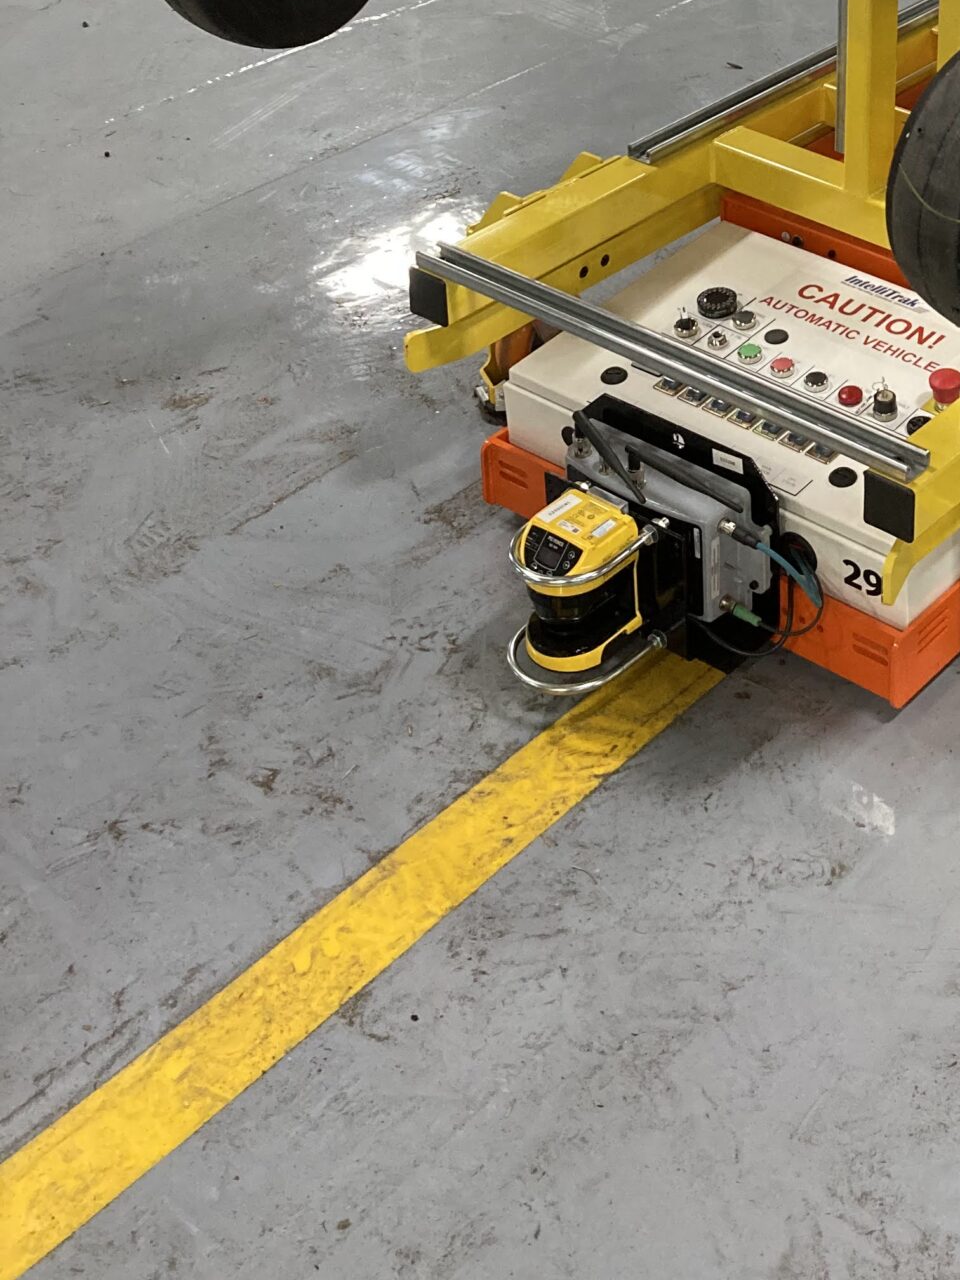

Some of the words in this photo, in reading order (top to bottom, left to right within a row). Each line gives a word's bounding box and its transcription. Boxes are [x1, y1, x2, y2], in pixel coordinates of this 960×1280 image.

[797, 283, 947, 350] CAUTION!
[844, 275, 922, 309] IntelliTrak
[760, 295, 862, 341] AUTOMATIC
[862, 334, 942, 373] VEHICLE
[842, 558, 883, 597] 29
